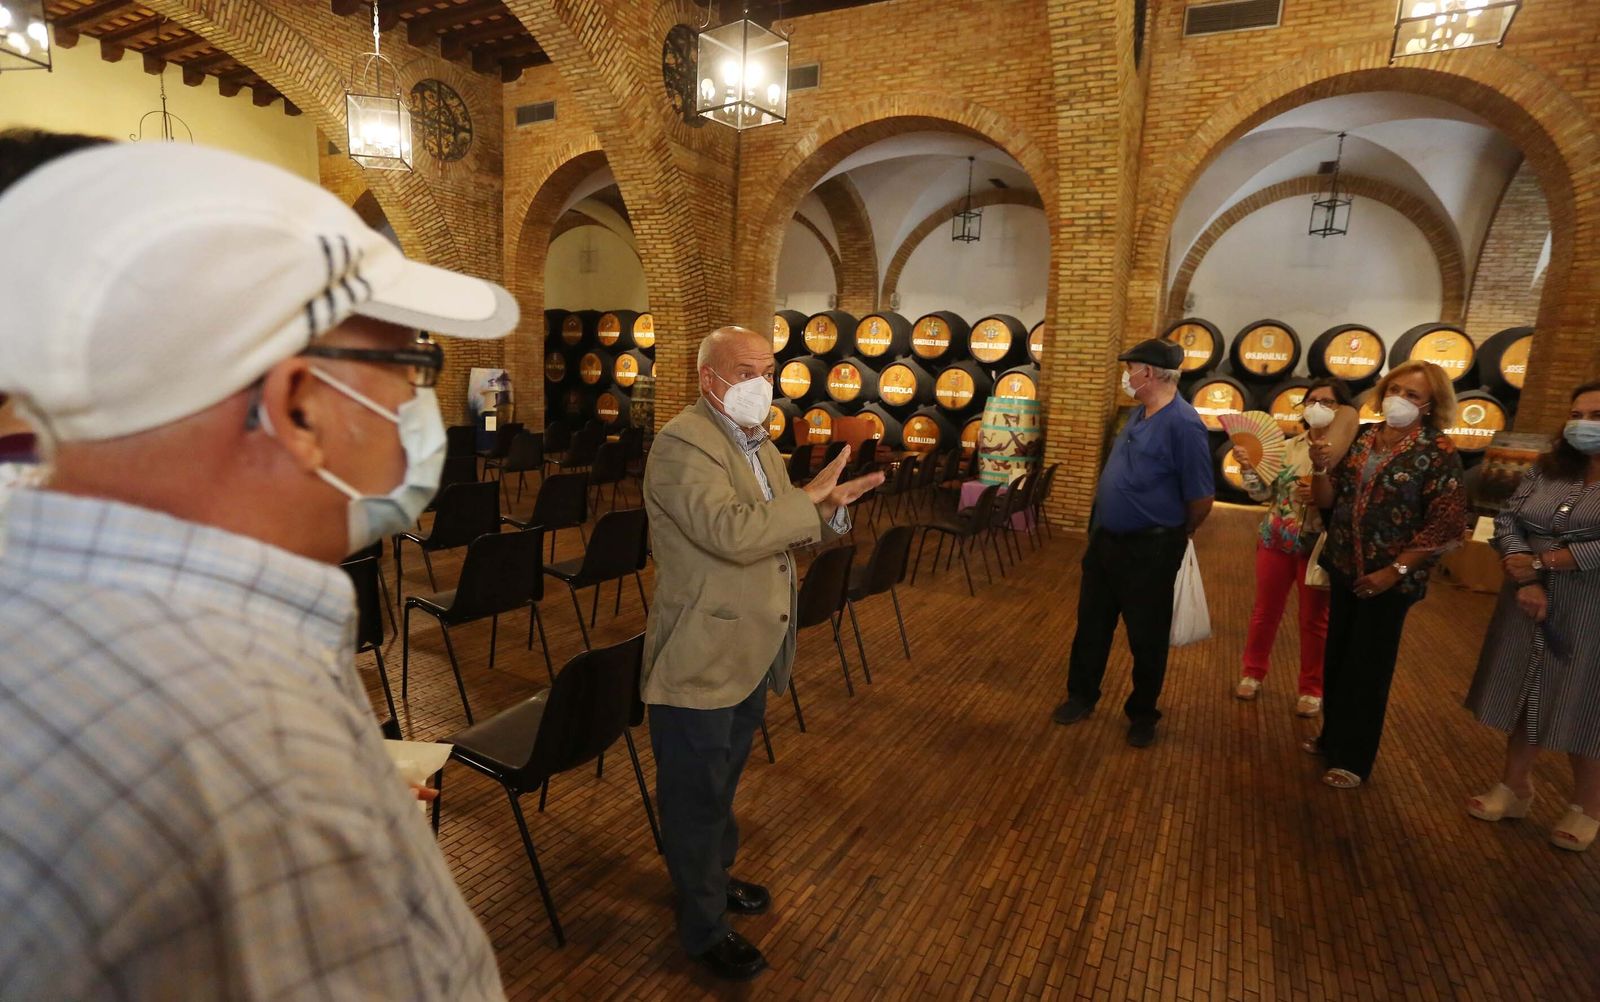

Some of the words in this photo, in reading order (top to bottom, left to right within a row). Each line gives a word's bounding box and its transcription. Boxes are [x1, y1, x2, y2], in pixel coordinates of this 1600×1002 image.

[1245, 351, 1288, 361] OSBORNE
[1329, 355, 1347, 365] PEREZ
[883, 385, 912, 394] BERTOLA
[1443, 427, 1496, 437] HARVEYS
[907, 436, 936, 445] CABALLERO
